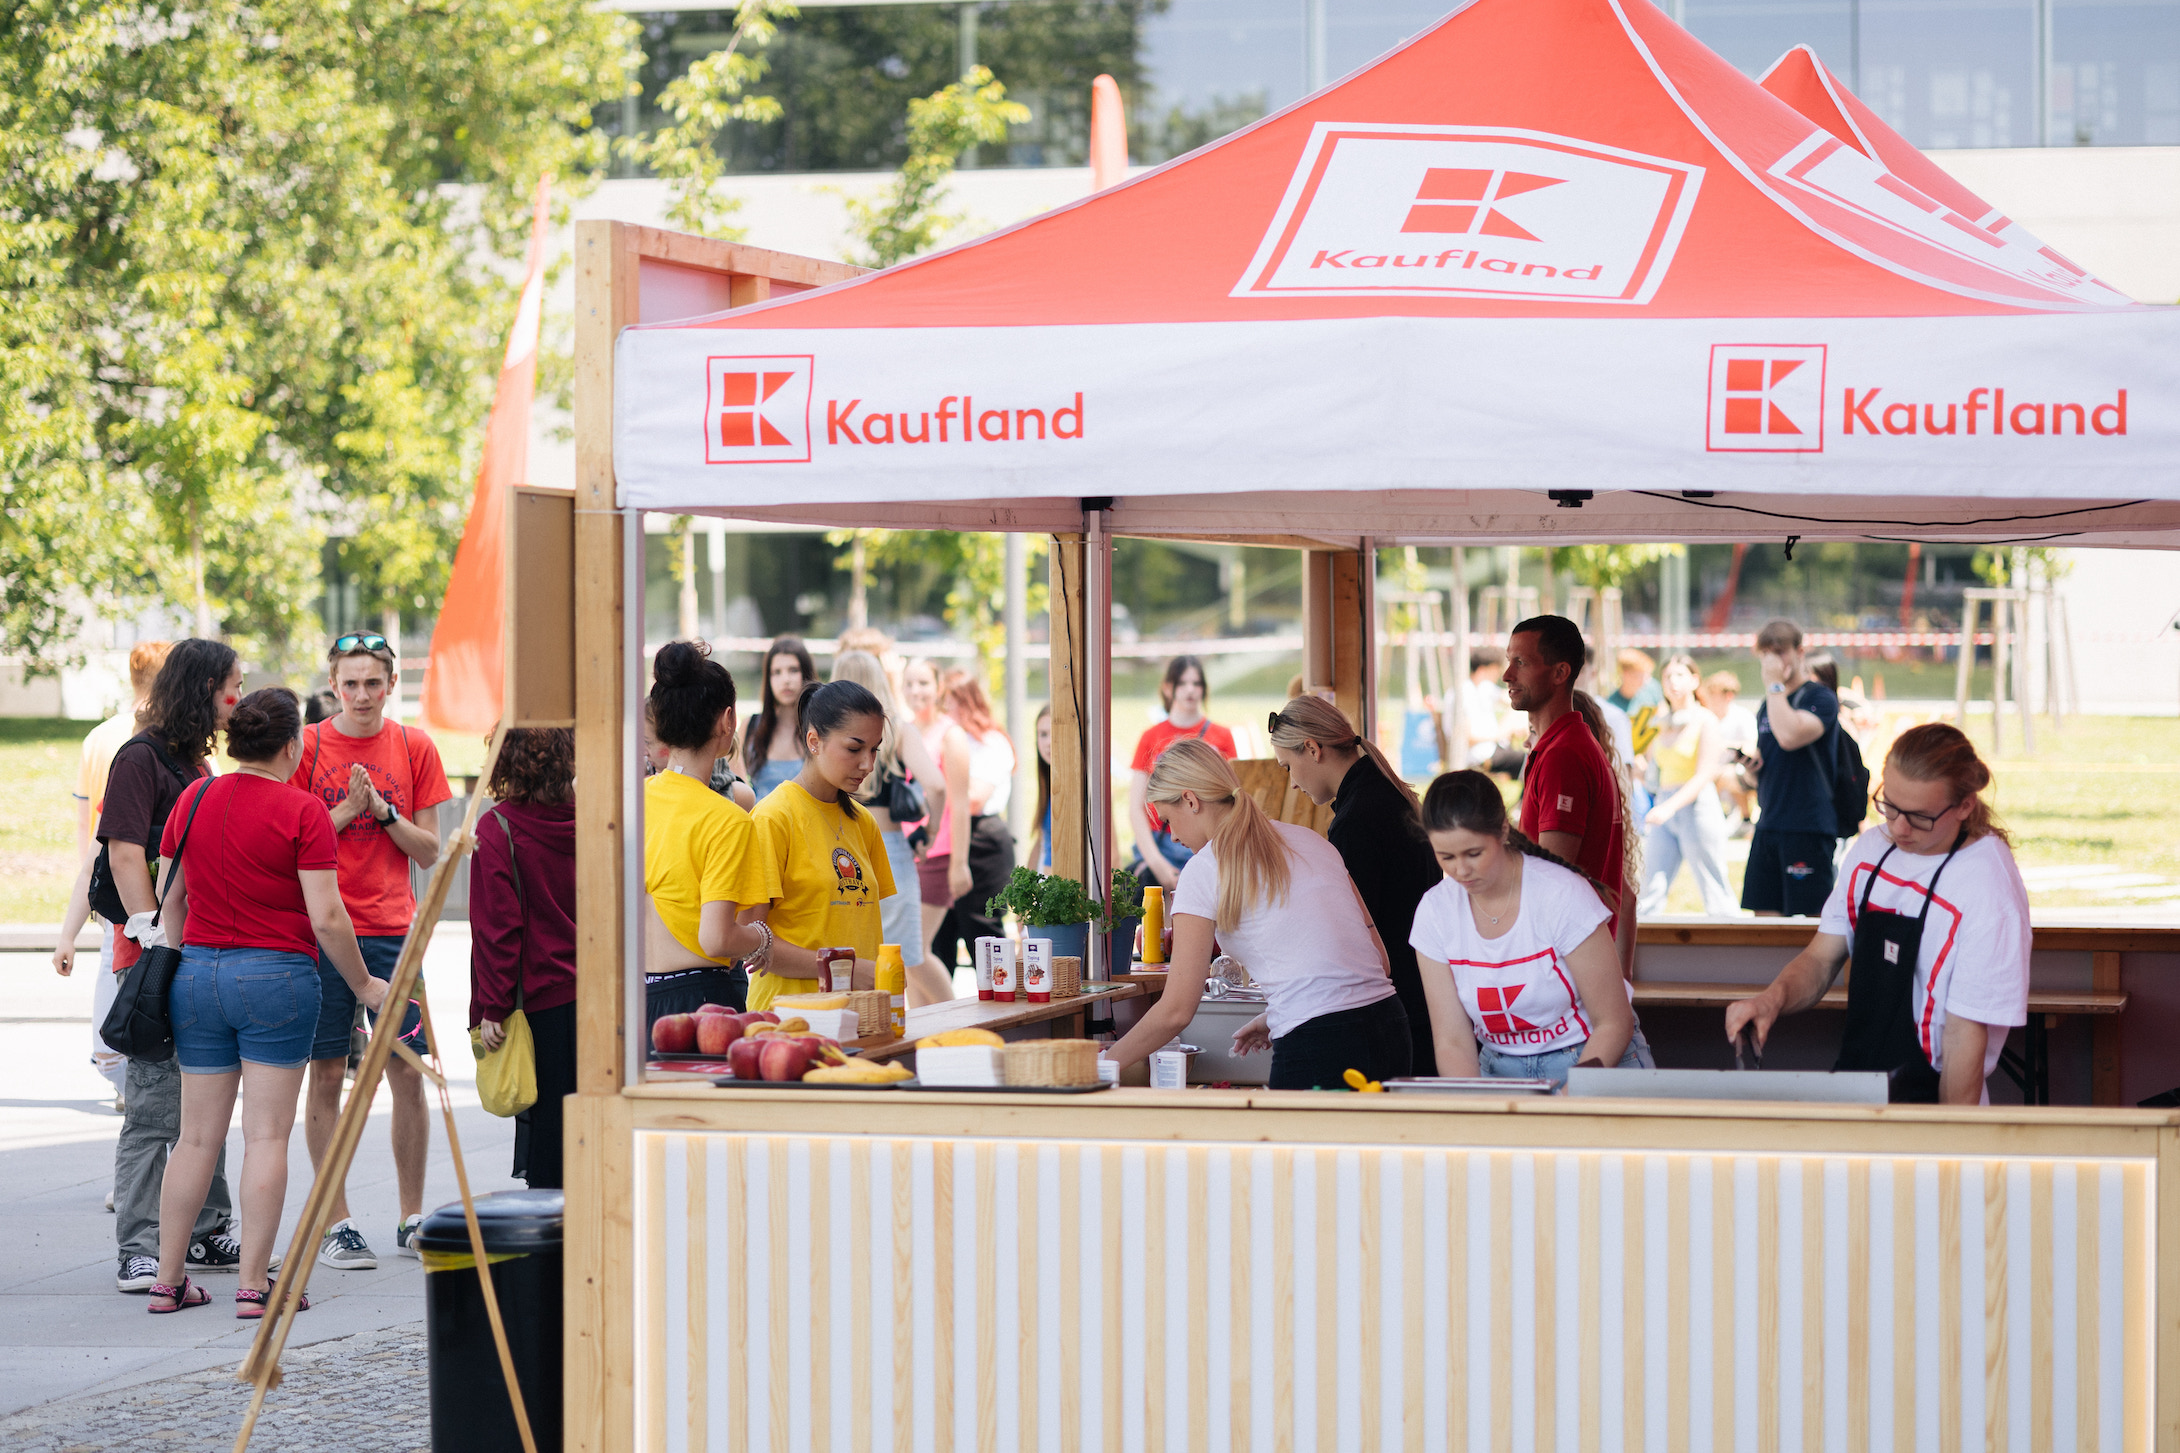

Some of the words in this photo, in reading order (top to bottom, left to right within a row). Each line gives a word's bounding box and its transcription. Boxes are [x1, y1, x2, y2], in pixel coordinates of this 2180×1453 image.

[1309, 249, 1604, 281] Kaufland
[826, 391, 1085, 446] Kaufland
[1842, 387, 2129, 437] Kaufland
[313, 766, 338, 795] PERIOR
[385, 772, 405, 809] QUALITY
[349, 822, 377, 831] MADE
[1475, 1016, 1569, 1045] aufland
